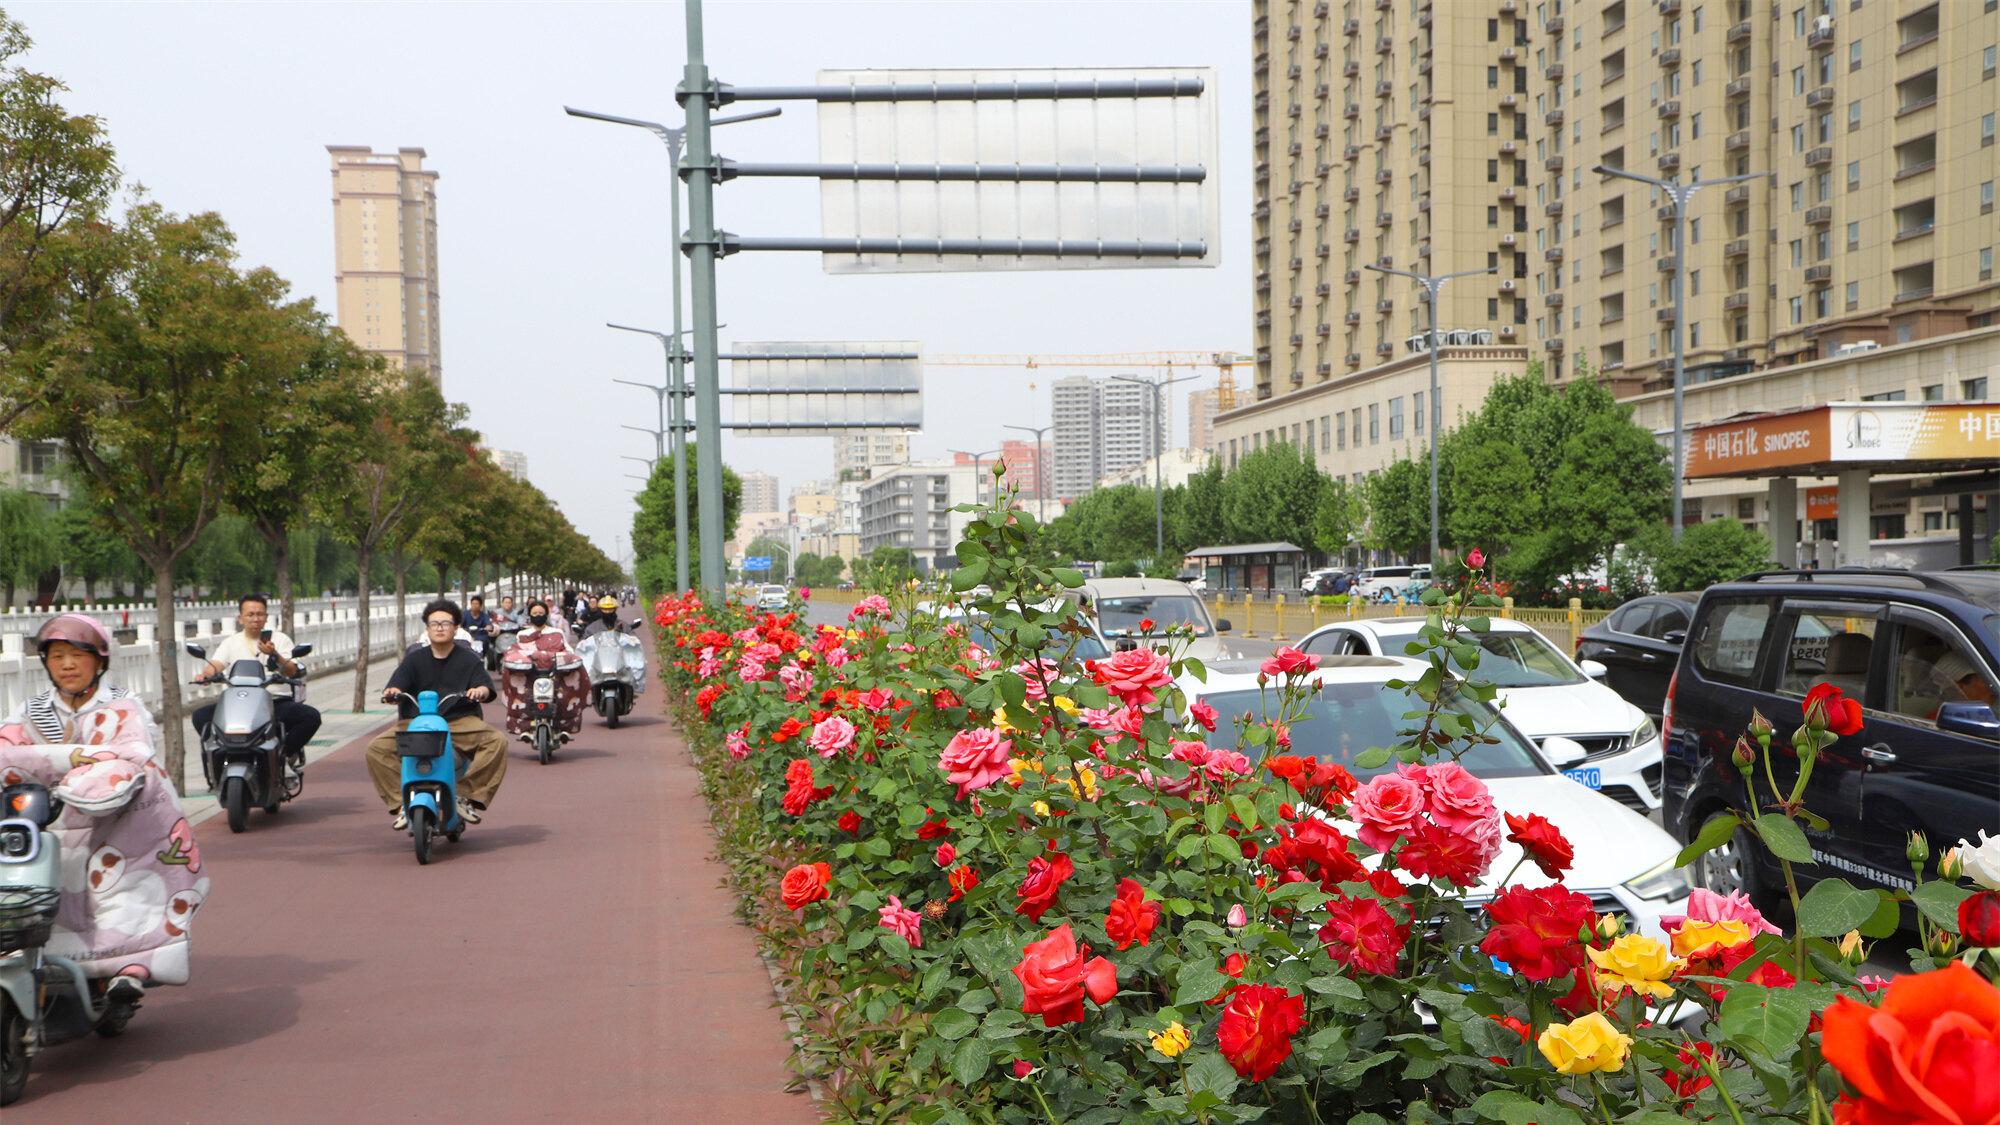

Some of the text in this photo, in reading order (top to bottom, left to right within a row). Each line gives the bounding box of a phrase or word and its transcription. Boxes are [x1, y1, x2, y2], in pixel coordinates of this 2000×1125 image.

[1704, 427, 1758, 460] 中国石化
[1764, 430, 1810, 452] SINOPEC
